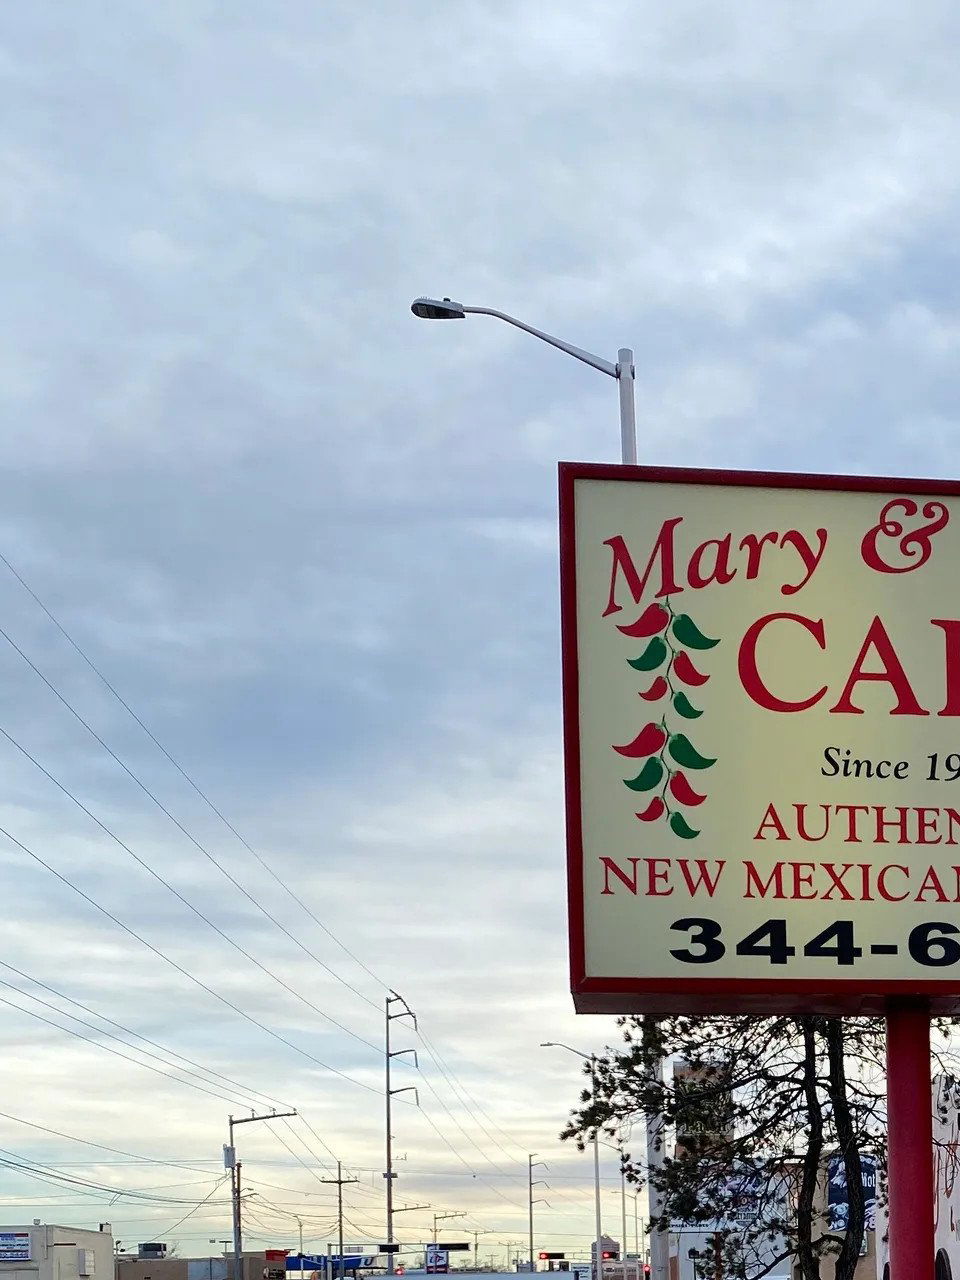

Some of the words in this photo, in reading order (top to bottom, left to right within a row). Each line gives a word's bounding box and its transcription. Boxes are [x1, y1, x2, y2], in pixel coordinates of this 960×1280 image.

[601, 517, 828, 618] Mary
[861, 498, 949, 574] &
[821, 746, 910, 780] Since
[598, 856, 727, 898] NEW
